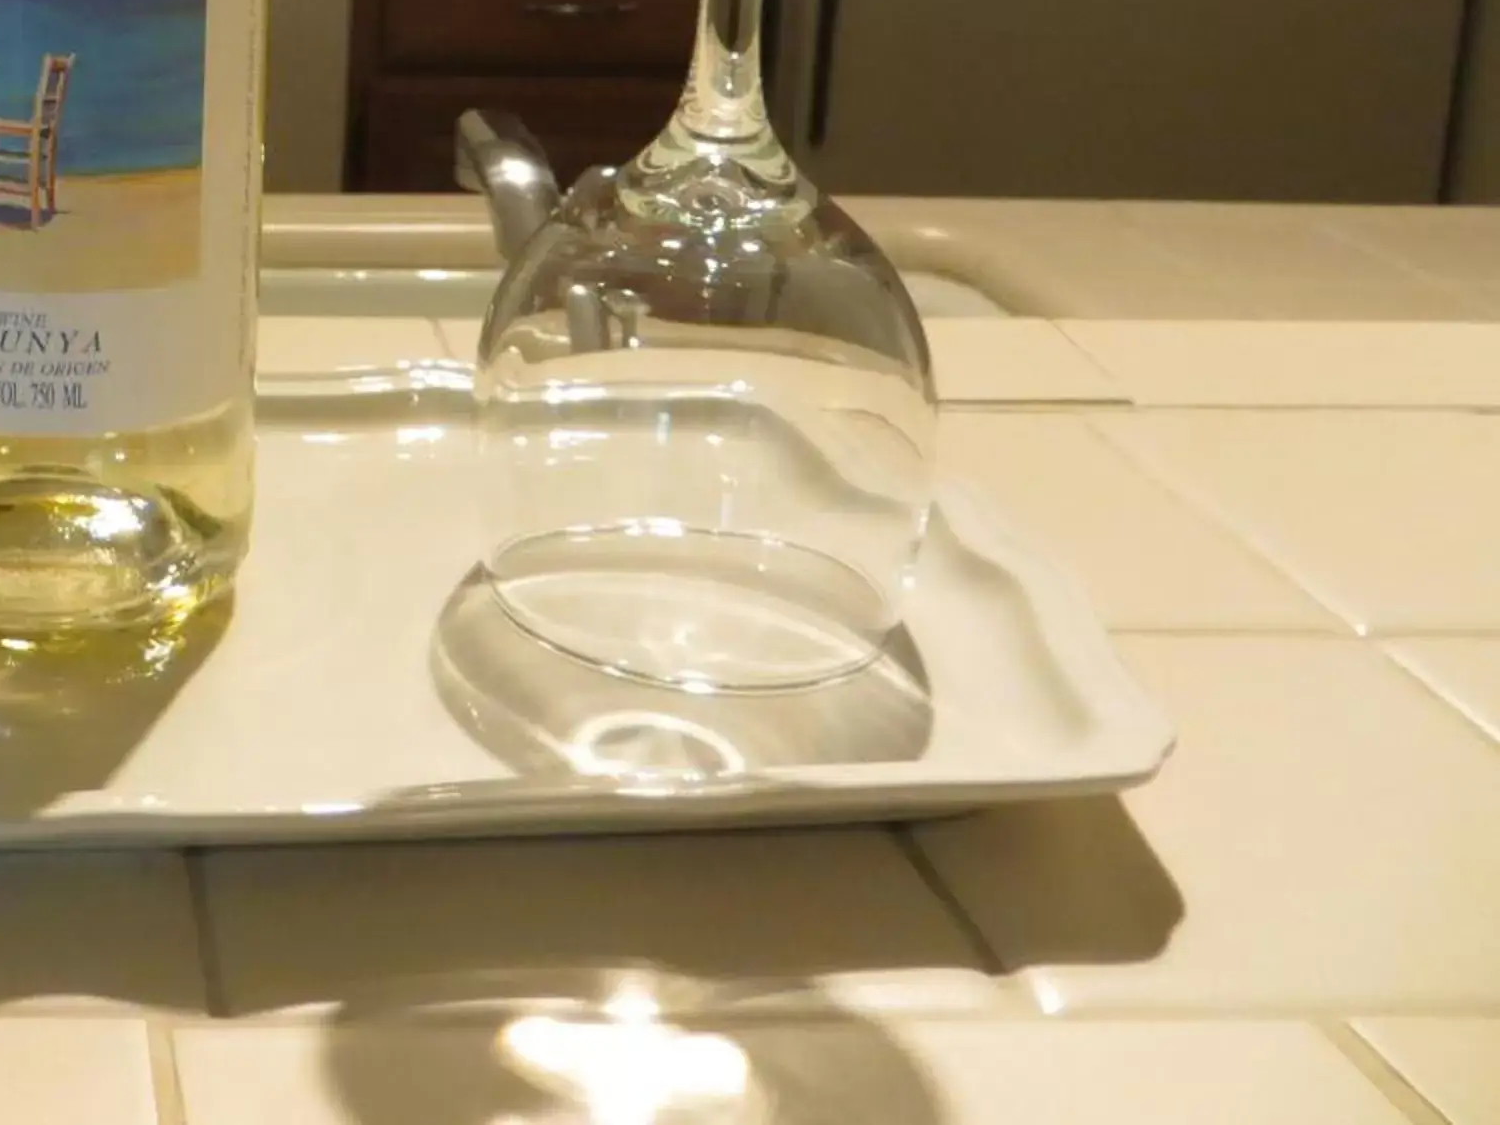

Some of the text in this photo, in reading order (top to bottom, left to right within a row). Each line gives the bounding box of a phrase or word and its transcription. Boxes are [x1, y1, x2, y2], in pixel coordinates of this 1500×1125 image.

[11, 360, 35, 376] DE
[40, 360, 111, 377] ORIGEN
[30, 380, 56, 410] 750
[63, 381, 88, 410] ML
